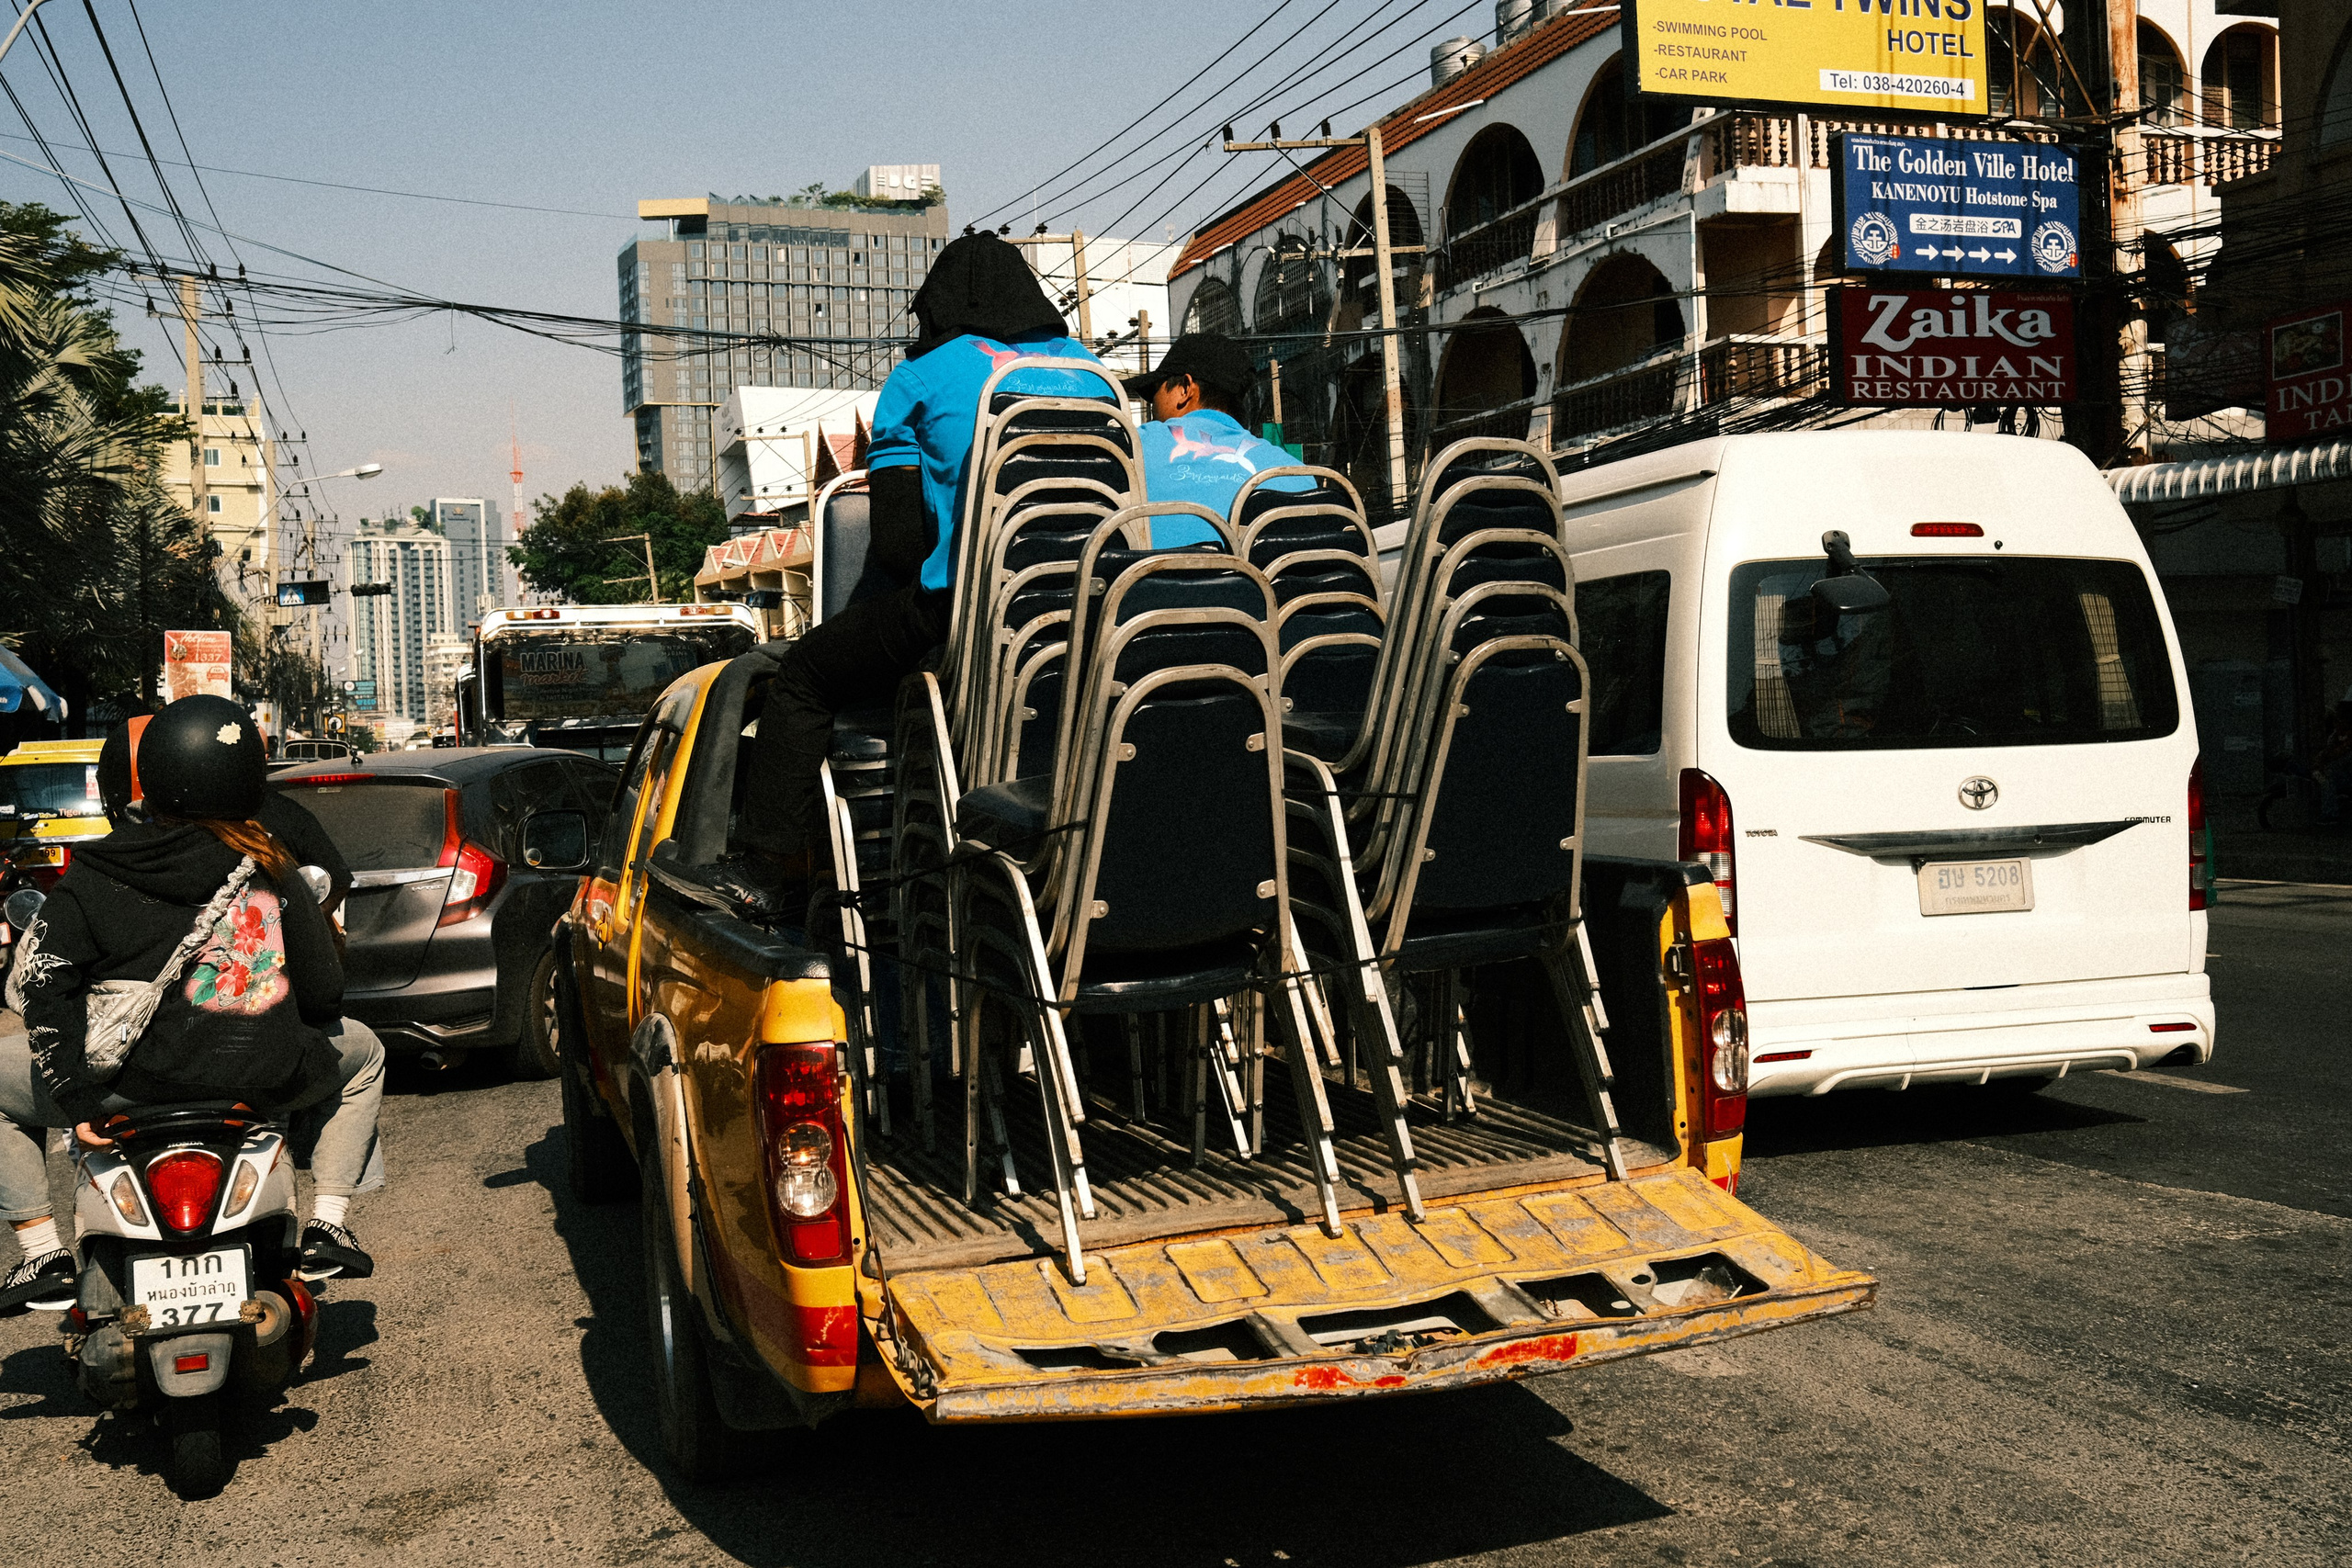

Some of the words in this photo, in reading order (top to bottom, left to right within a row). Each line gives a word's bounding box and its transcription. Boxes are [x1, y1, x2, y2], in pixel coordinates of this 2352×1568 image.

[1652, 20, 1727, 39] -SWIMMING
[1731, 27, 1768, 41] POOL
[1653, 44, 1747, 62] -RESTAURANT
[1887, 29, 1974, 58] HOTEL
[1655, 67, 1688, 81] -CAR
[1691, 70, 1728, 84] PARK
[1829, 73, 1858, 89] Tel:
[1863, 74, 1965, 96] 038-420260-4
[1853, 145, 1892, 173] The
[1898, 148, 1967, 177] Golden
[1973, 152, 2016, 180] Ville
[2021, 155, 2075, 183] Hotel
[876, 175, 934, 191] EDGE
[1871, 181, 1962, 204] KANENOYU
[1965, 187, 2028, 207] Hotstone
[2032, 191, 2057, 212] Spa
[1915, 218, 1989, 234] 金之汤岩盘浴
[1992, 220, 2017, 234] SPA
[1860, 295, 2057, 352] Zaika
[1850, 355, 2064, 379] INDIAN
[1851, 381, 2066, 400] RESTAURANT
[520, 651, 587, 672] MARINA
[519, 665, 590, 686] market
[59, 808, 81, 818] Tiger
[1745, 829, 1779, 838] TOYOTA
[1974, 865, 2019, 887] 5208
[166, 1140, 205, 1149] HONDA
[160, 1254, 222, 1279] 1กก
[147, 1280, 236, 1302] หนองบัวลำภู
[161, 1302, 224, 1327] 377
